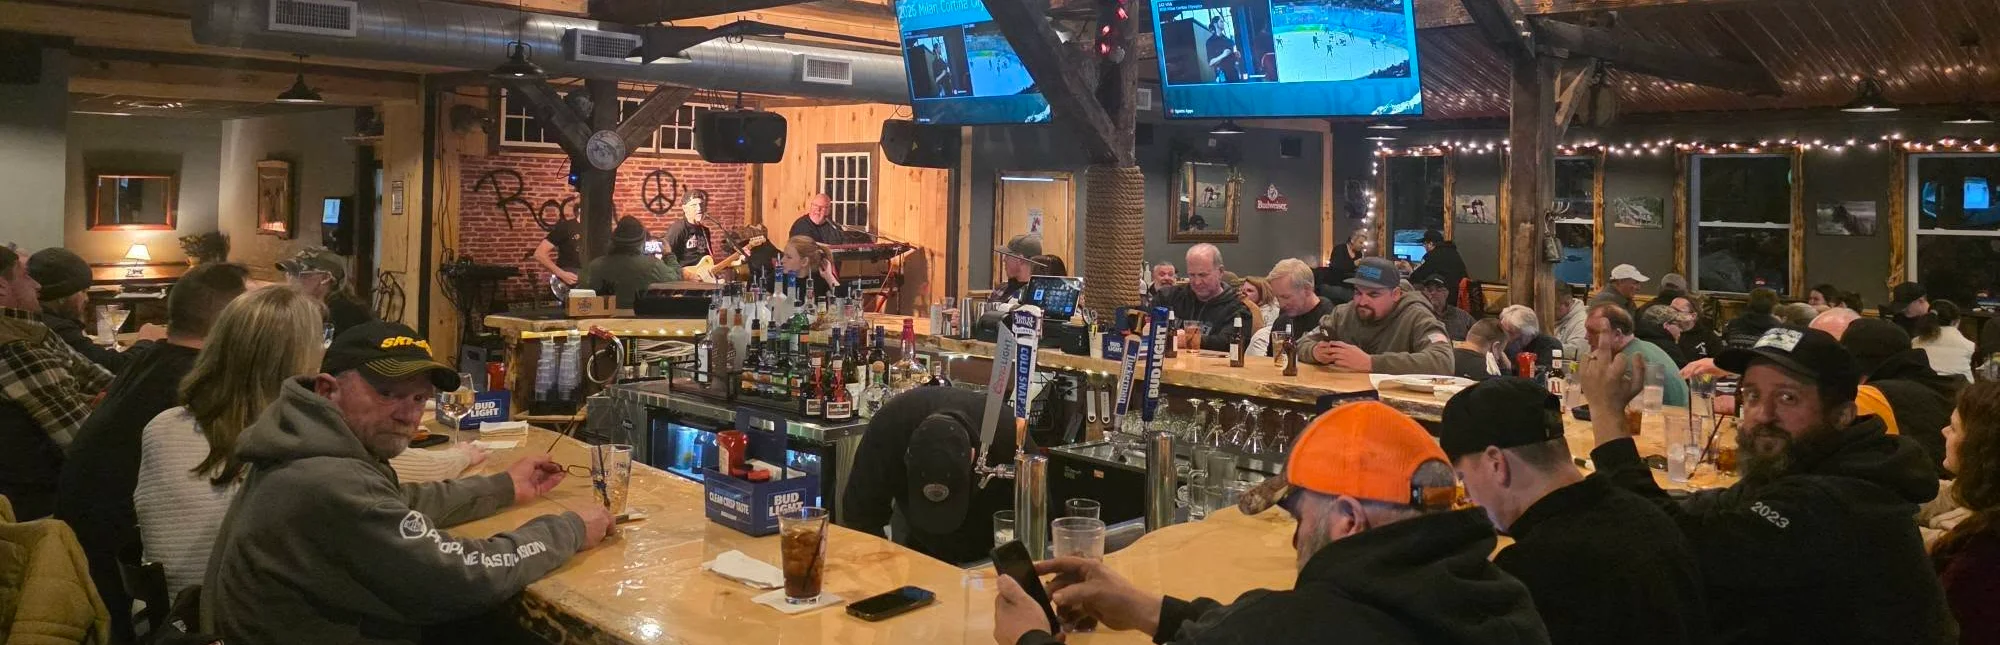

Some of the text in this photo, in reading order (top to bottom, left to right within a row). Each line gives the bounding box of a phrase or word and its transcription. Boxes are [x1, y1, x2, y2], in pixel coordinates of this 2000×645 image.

[901, 4, 917, 18] 2026
[919, 3, 938, 16] Milan
[474, 169, 616, 232] Roc
[1019, 346, 1029, 374] COLD
[1147, 325, 1168, 398] BUD LIGHT
[1018, 375, 1028, 404] SNAP
[470, 408, 500, 418] LIGHT
[474, 401, 496, 410] BUD
[709, 491, 724, 505] CLEAN
[723, 497, 736, 510] CRISP
[736, 503, 750, 515] TASTE
[768, 501, 804, 517] LIGHT
[774, 492, 800, 506] BUD
[1750, 501, 1790, 528] 2023
